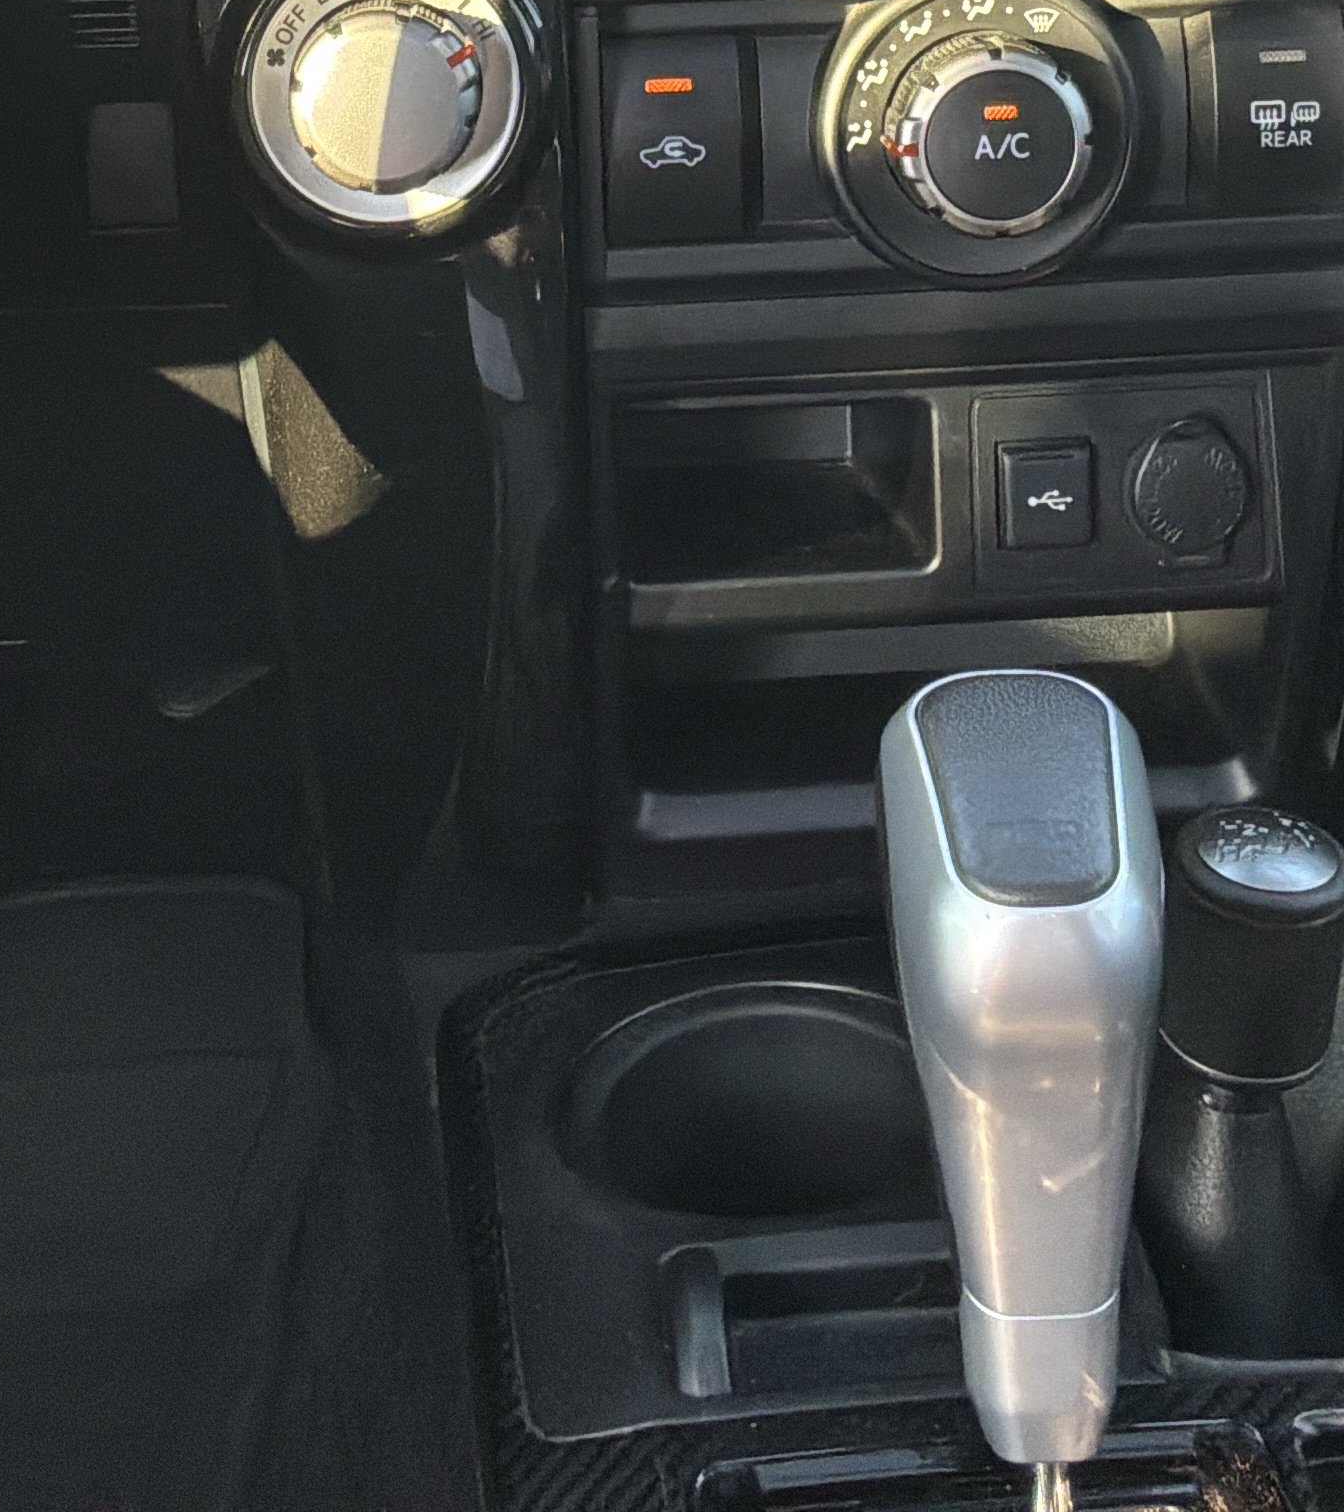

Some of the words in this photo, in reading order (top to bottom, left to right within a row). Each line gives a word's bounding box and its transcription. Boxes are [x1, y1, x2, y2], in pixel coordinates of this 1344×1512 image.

[274, 4, 308, 46] OFF
[974, 132, 1031, 160] A/C
[1260, 129, 1313, 148] REAR
